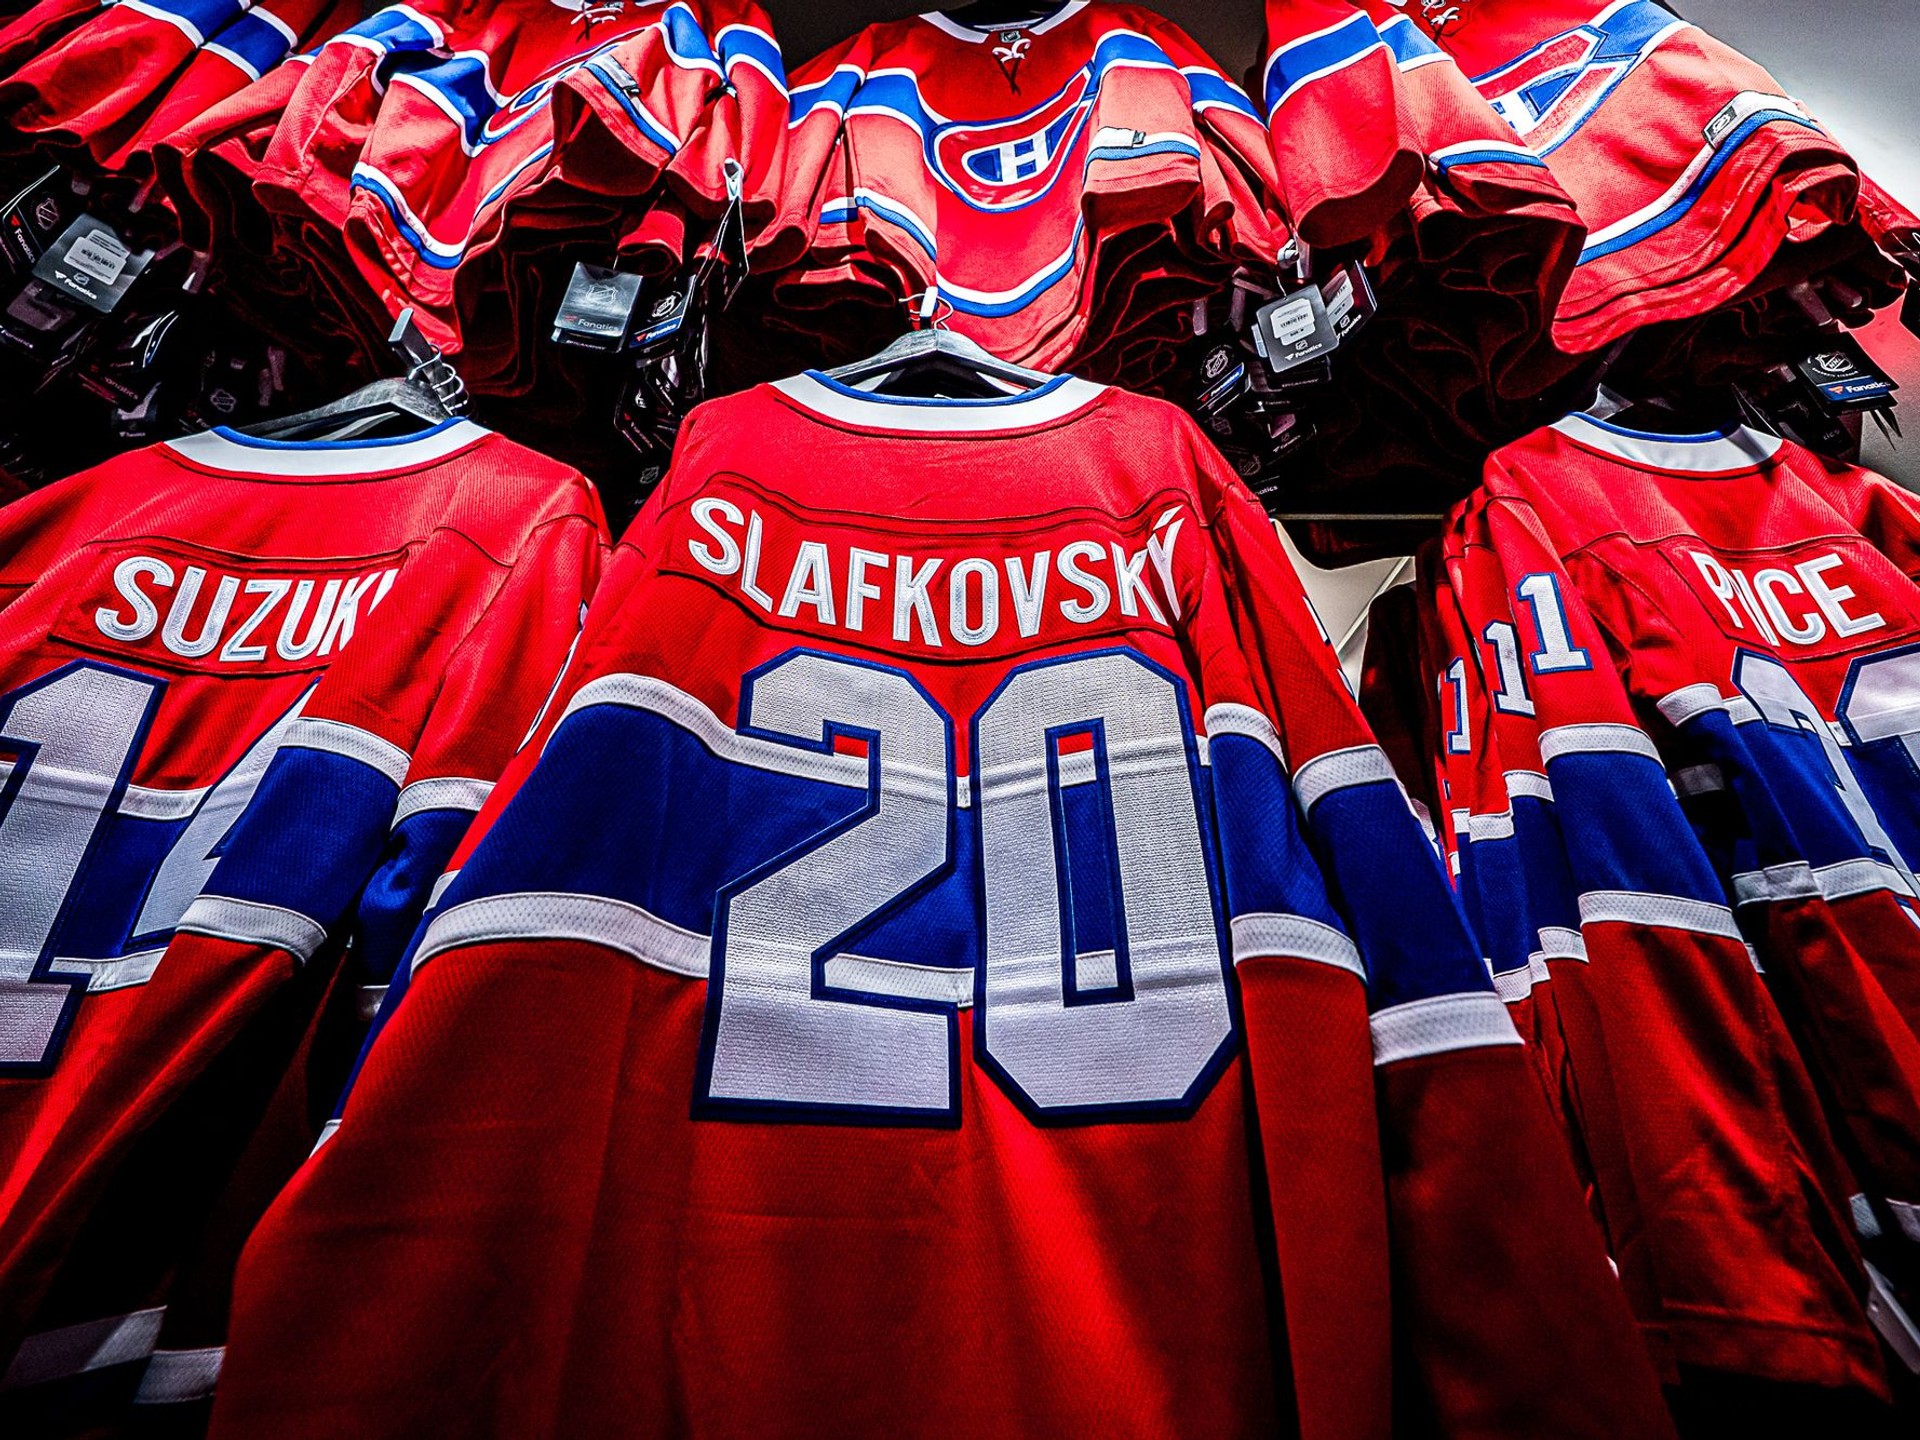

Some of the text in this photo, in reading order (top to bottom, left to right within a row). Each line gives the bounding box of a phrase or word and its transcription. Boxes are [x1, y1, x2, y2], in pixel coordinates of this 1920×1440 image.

[14, 228, 36, 264] Fanatics
[64, 278, 98, 300] Fanatics
[577, 318, 620, 332] Fanatics
[1846, 381, 1891, 394] Fanatics
[688, 497, 1186, 647] SLAFKOVSKÝ
[690, 645, 1245, 1128] 20
